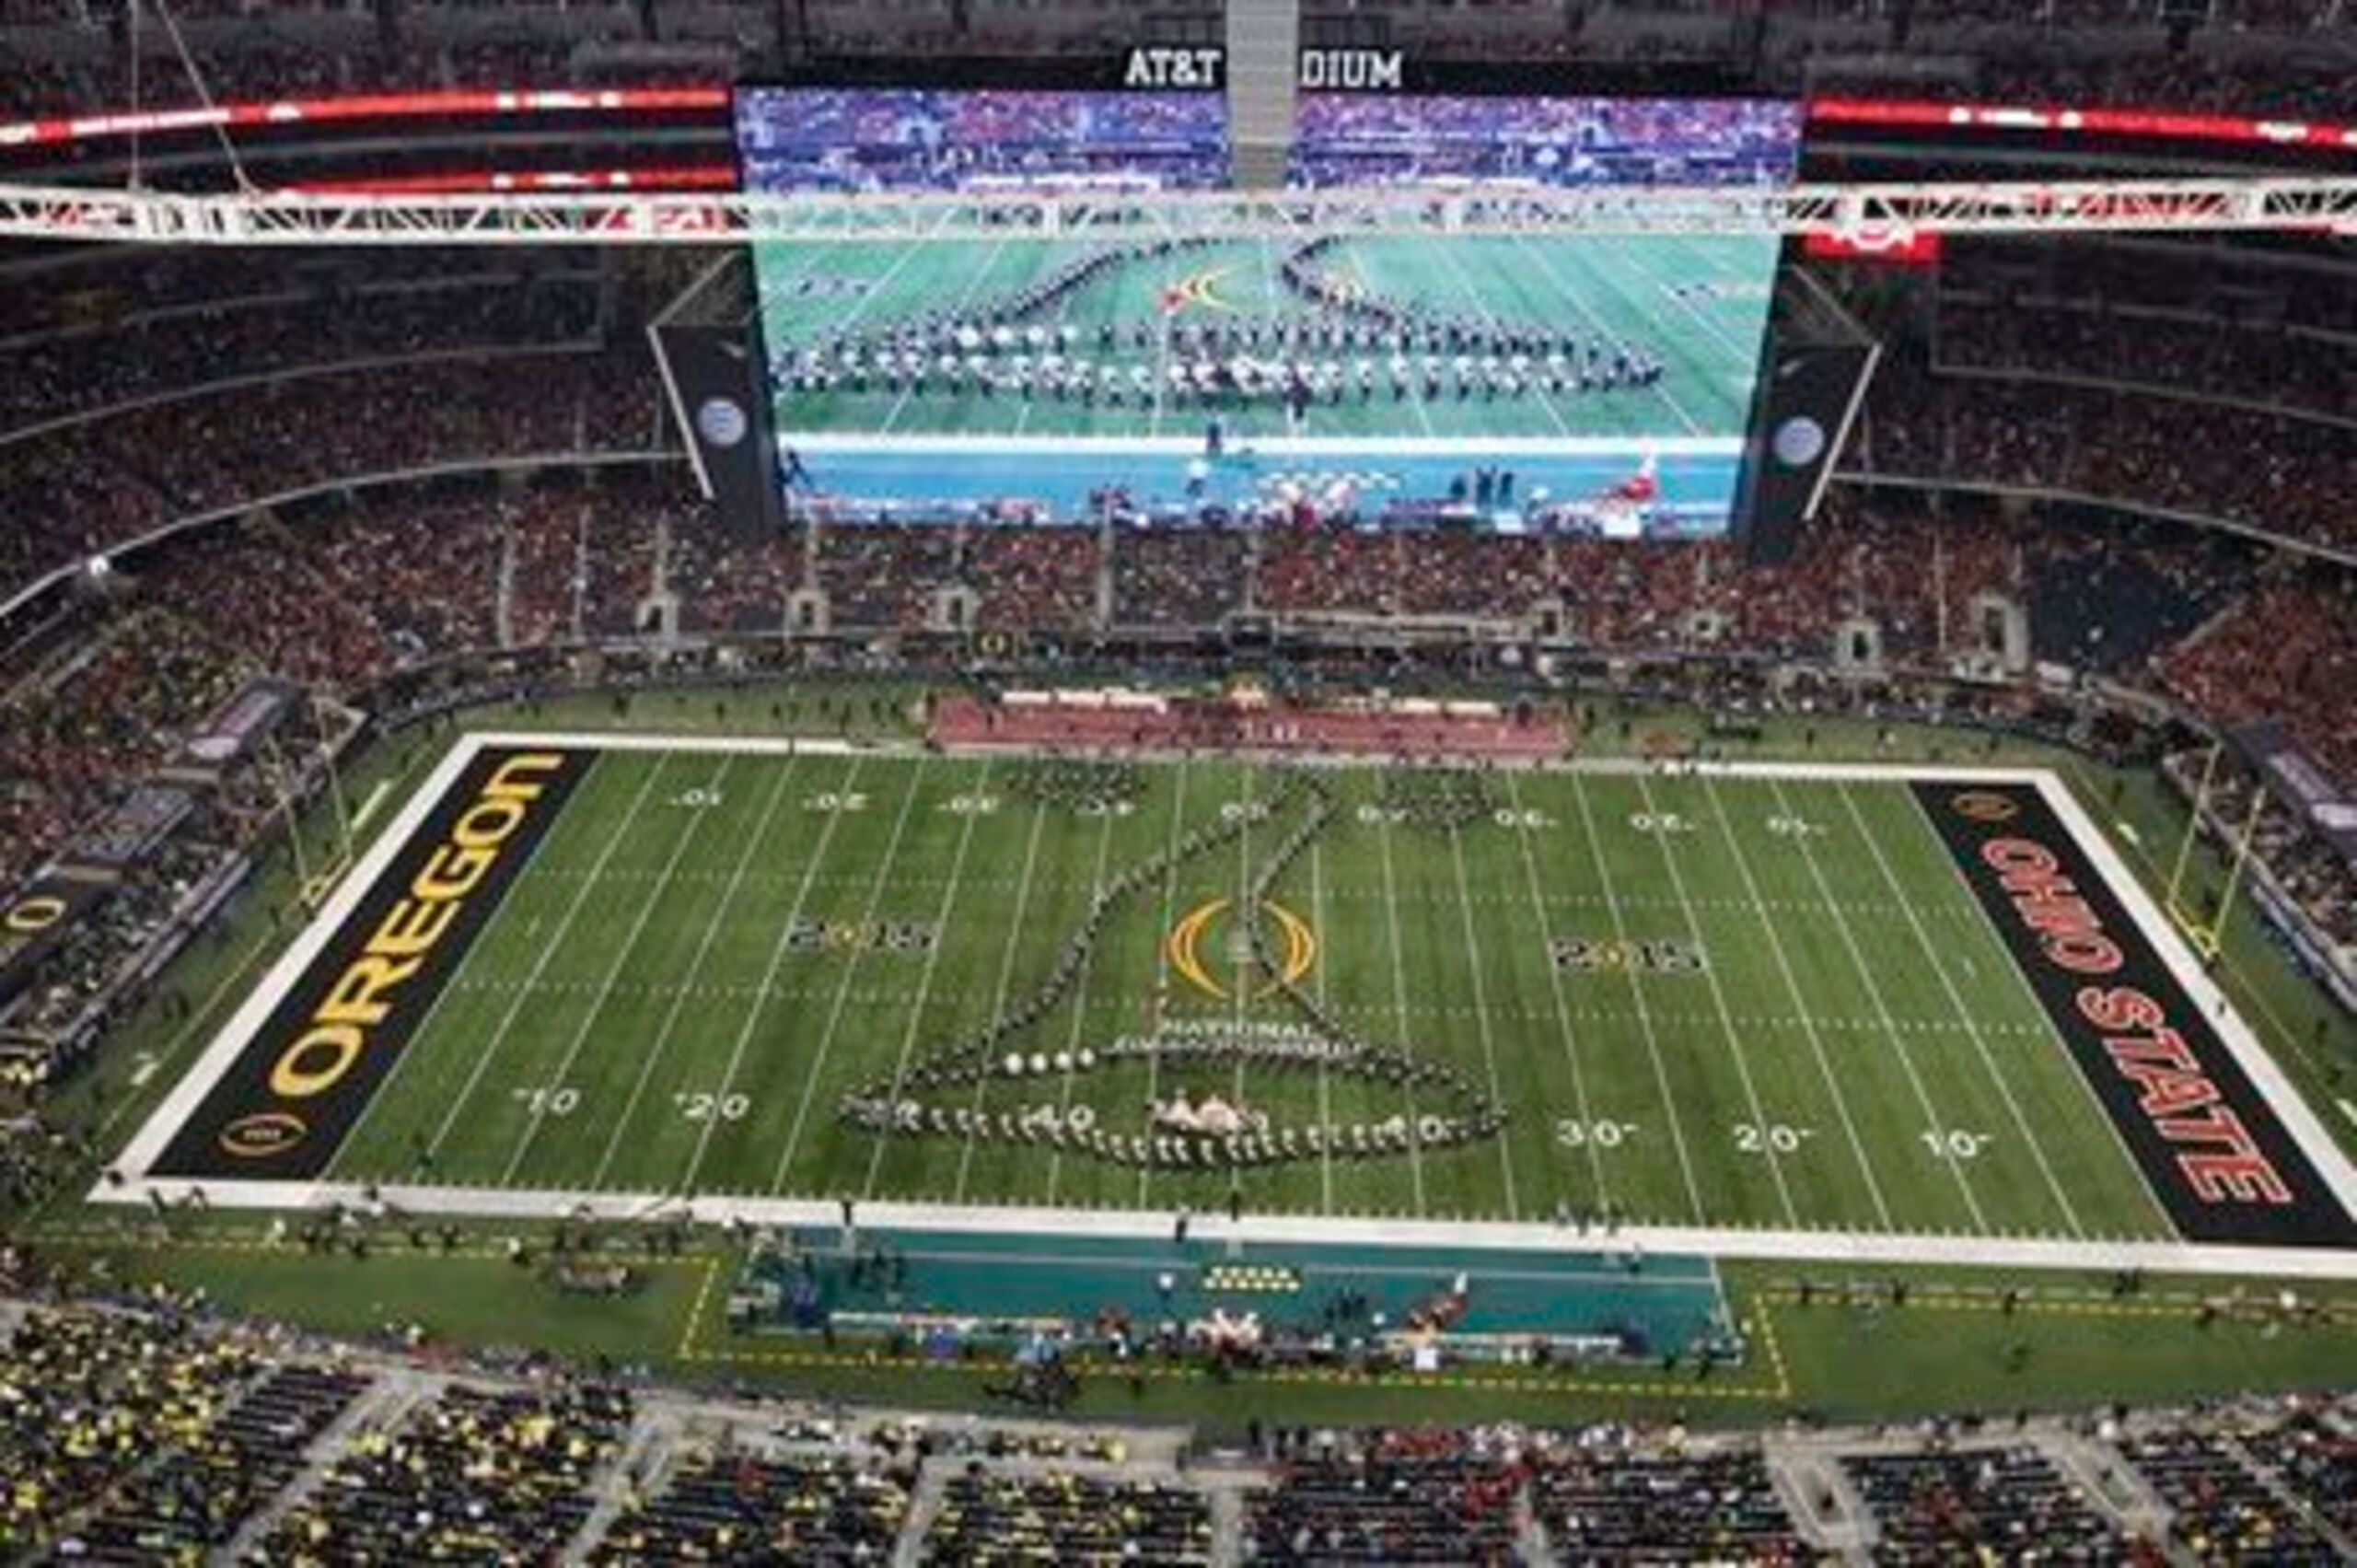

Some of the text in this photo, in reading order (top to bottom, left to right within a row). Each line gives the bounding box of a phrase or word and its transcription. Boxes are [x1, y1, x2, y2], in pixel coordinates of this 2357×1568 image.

[1125, 49, 1402, 88] AT&T DIUM
[269, 753, 565, 1098] OREGON
[1980, 836, 2293, 1203] OHIO STATE
[528, 1088, 579, 1117] 10
[683, 1093, 749, 1121] 20
[1557, 1120, 1621, 1147] 30
[1735, 1124, 1798, 1152] 20
[1921, 1131, 1978, 1158] 10
